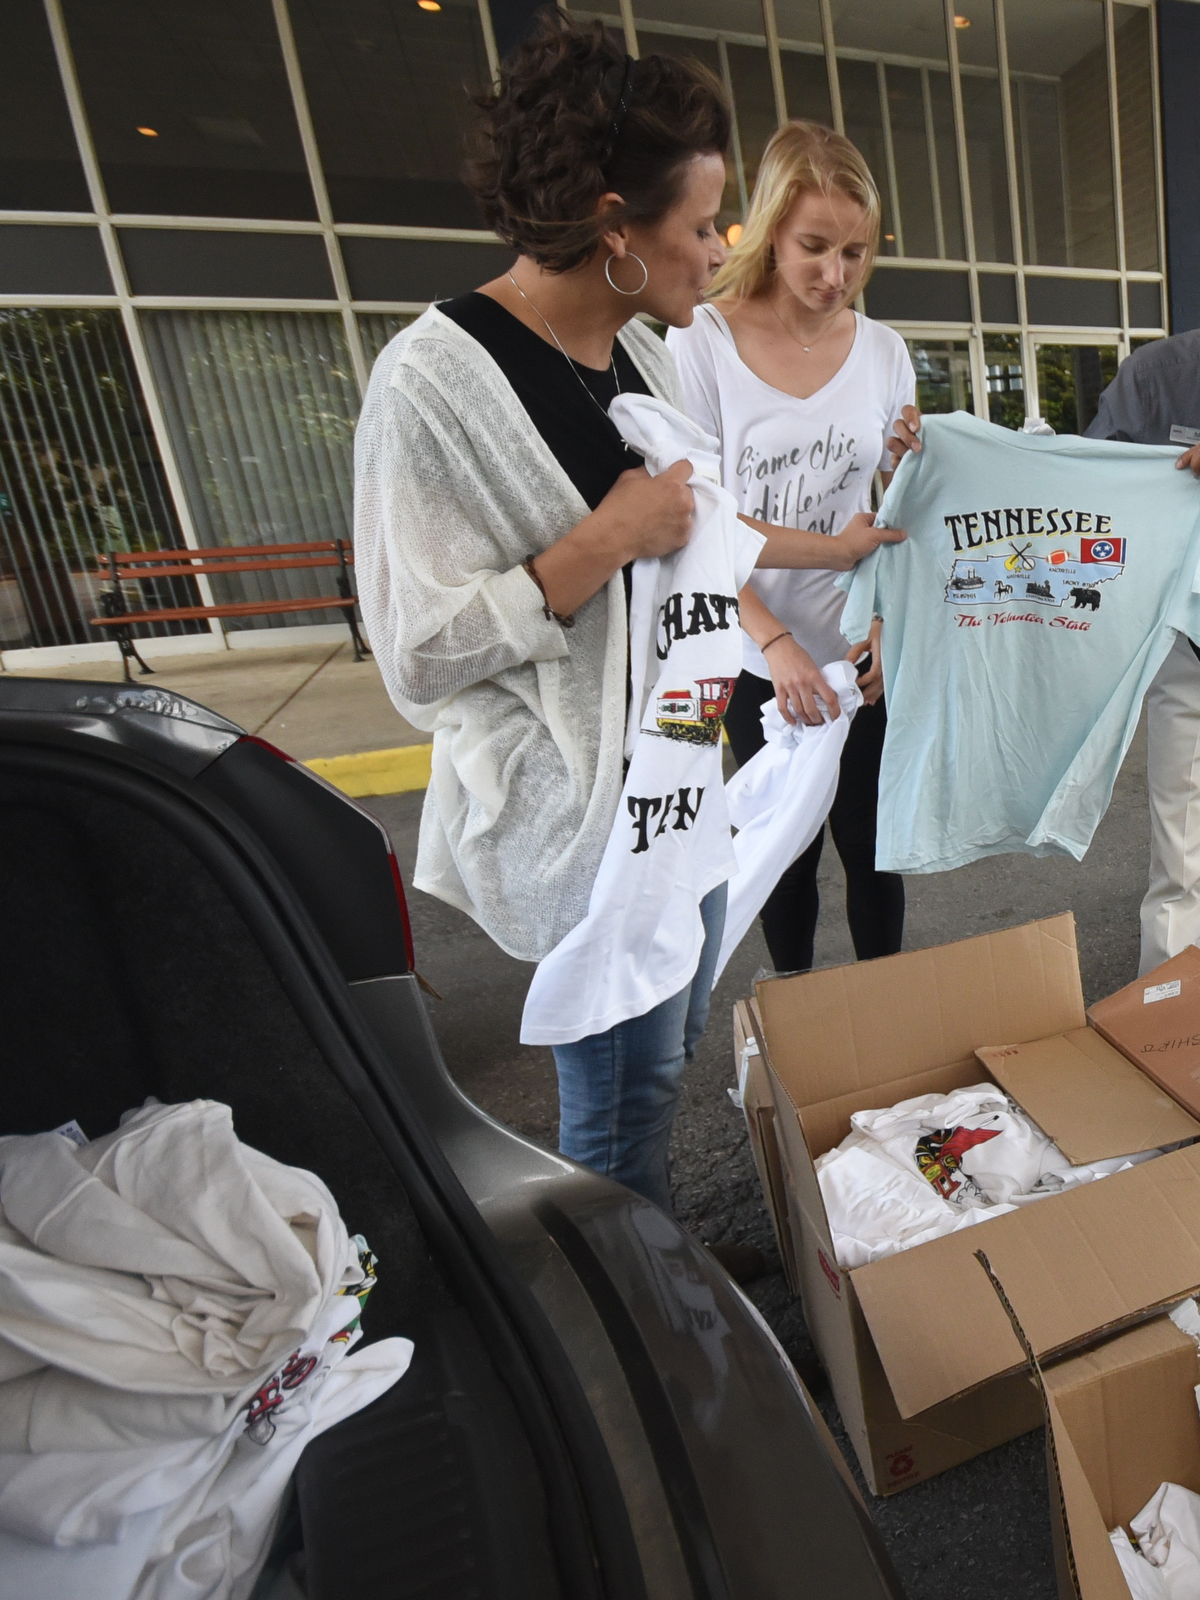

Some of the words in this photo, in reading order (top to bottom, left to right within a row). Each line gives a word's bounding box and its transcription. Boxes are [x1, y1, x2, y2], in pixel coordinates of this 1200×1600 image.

[944, 508, 1112, 552] TENNESSEE
[954, 613, 983, 628] The
[987, 611, 1044, 627] Volunteer
[1049, 616, 1092, 631] State
